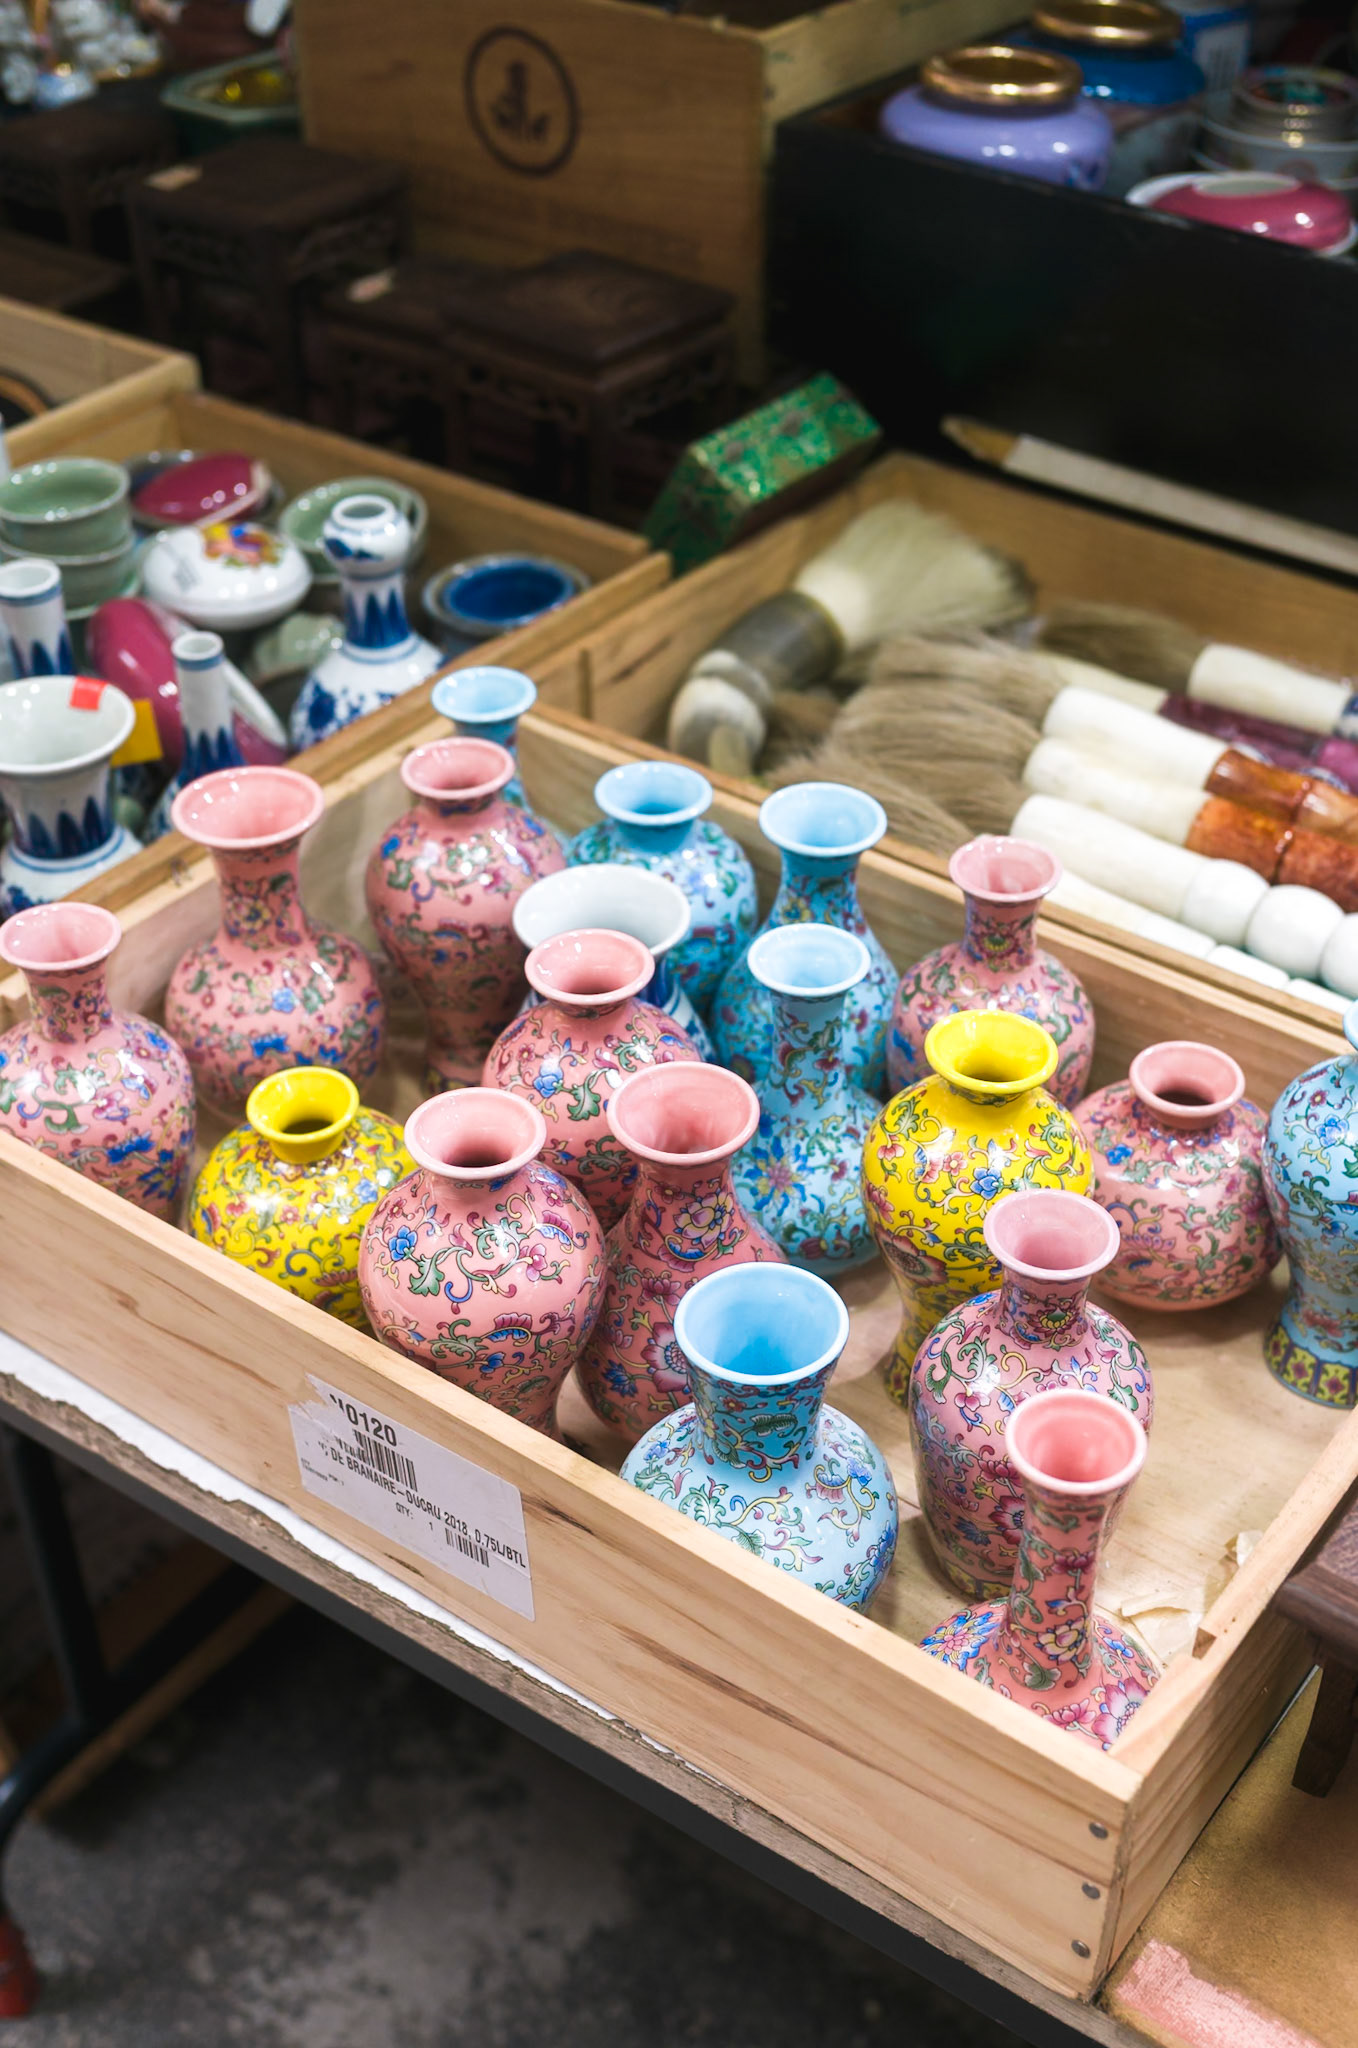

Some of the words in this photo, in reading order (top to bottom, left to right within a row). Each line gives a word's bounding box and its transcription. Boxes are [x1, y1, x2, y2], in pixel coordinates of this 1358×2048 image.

[346, 1456, 441, 1520] BRANAIRE-DUCRU
[444, 1512, 472, 1541] 2018,
[475, 1529, 526, 1568] 0.75L/BTL
[395, 1502, 414, 1520] QTY:
